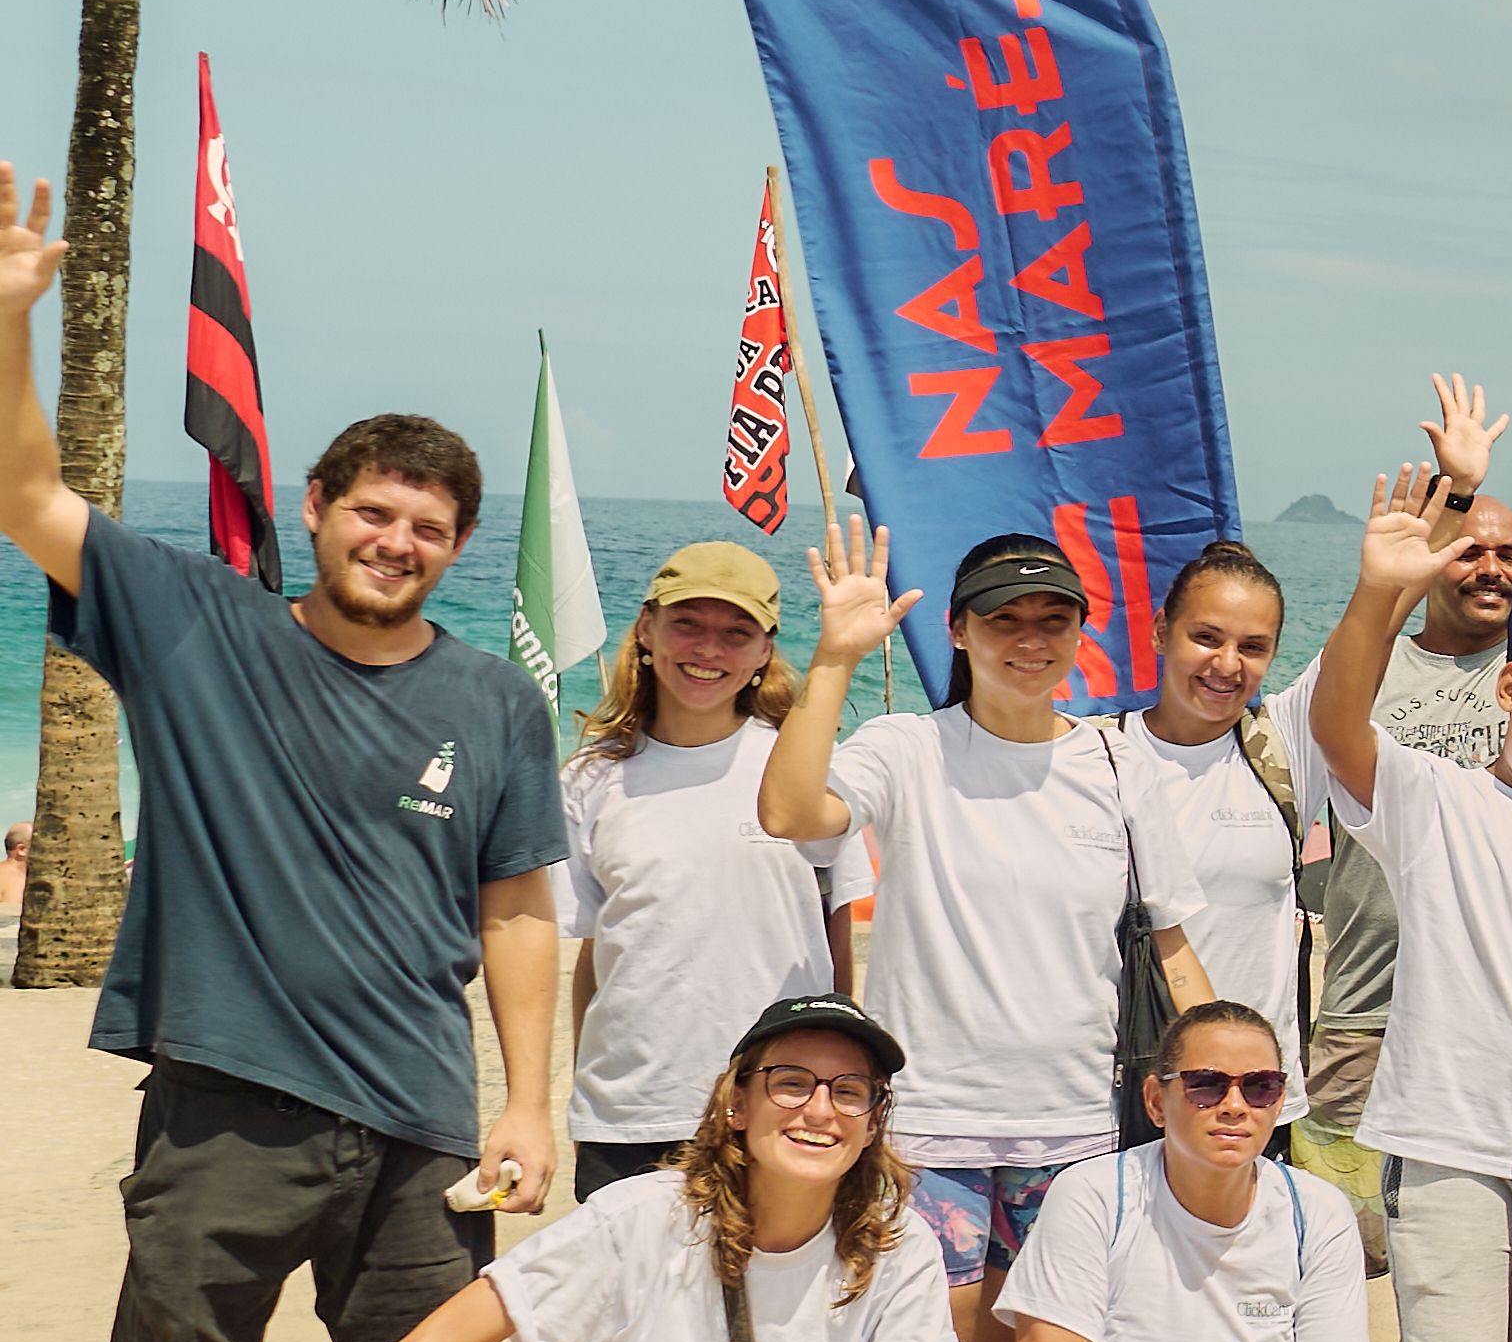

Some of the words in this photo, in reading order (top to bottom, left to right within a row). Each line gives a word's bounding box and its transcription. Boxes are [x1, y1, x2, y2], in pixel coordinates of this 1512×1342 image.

[869, 158, 1014, 460] NAS
[1435, 688, 1492, 713] SUPLY
[398, 795, 454, 820] ReMAR
